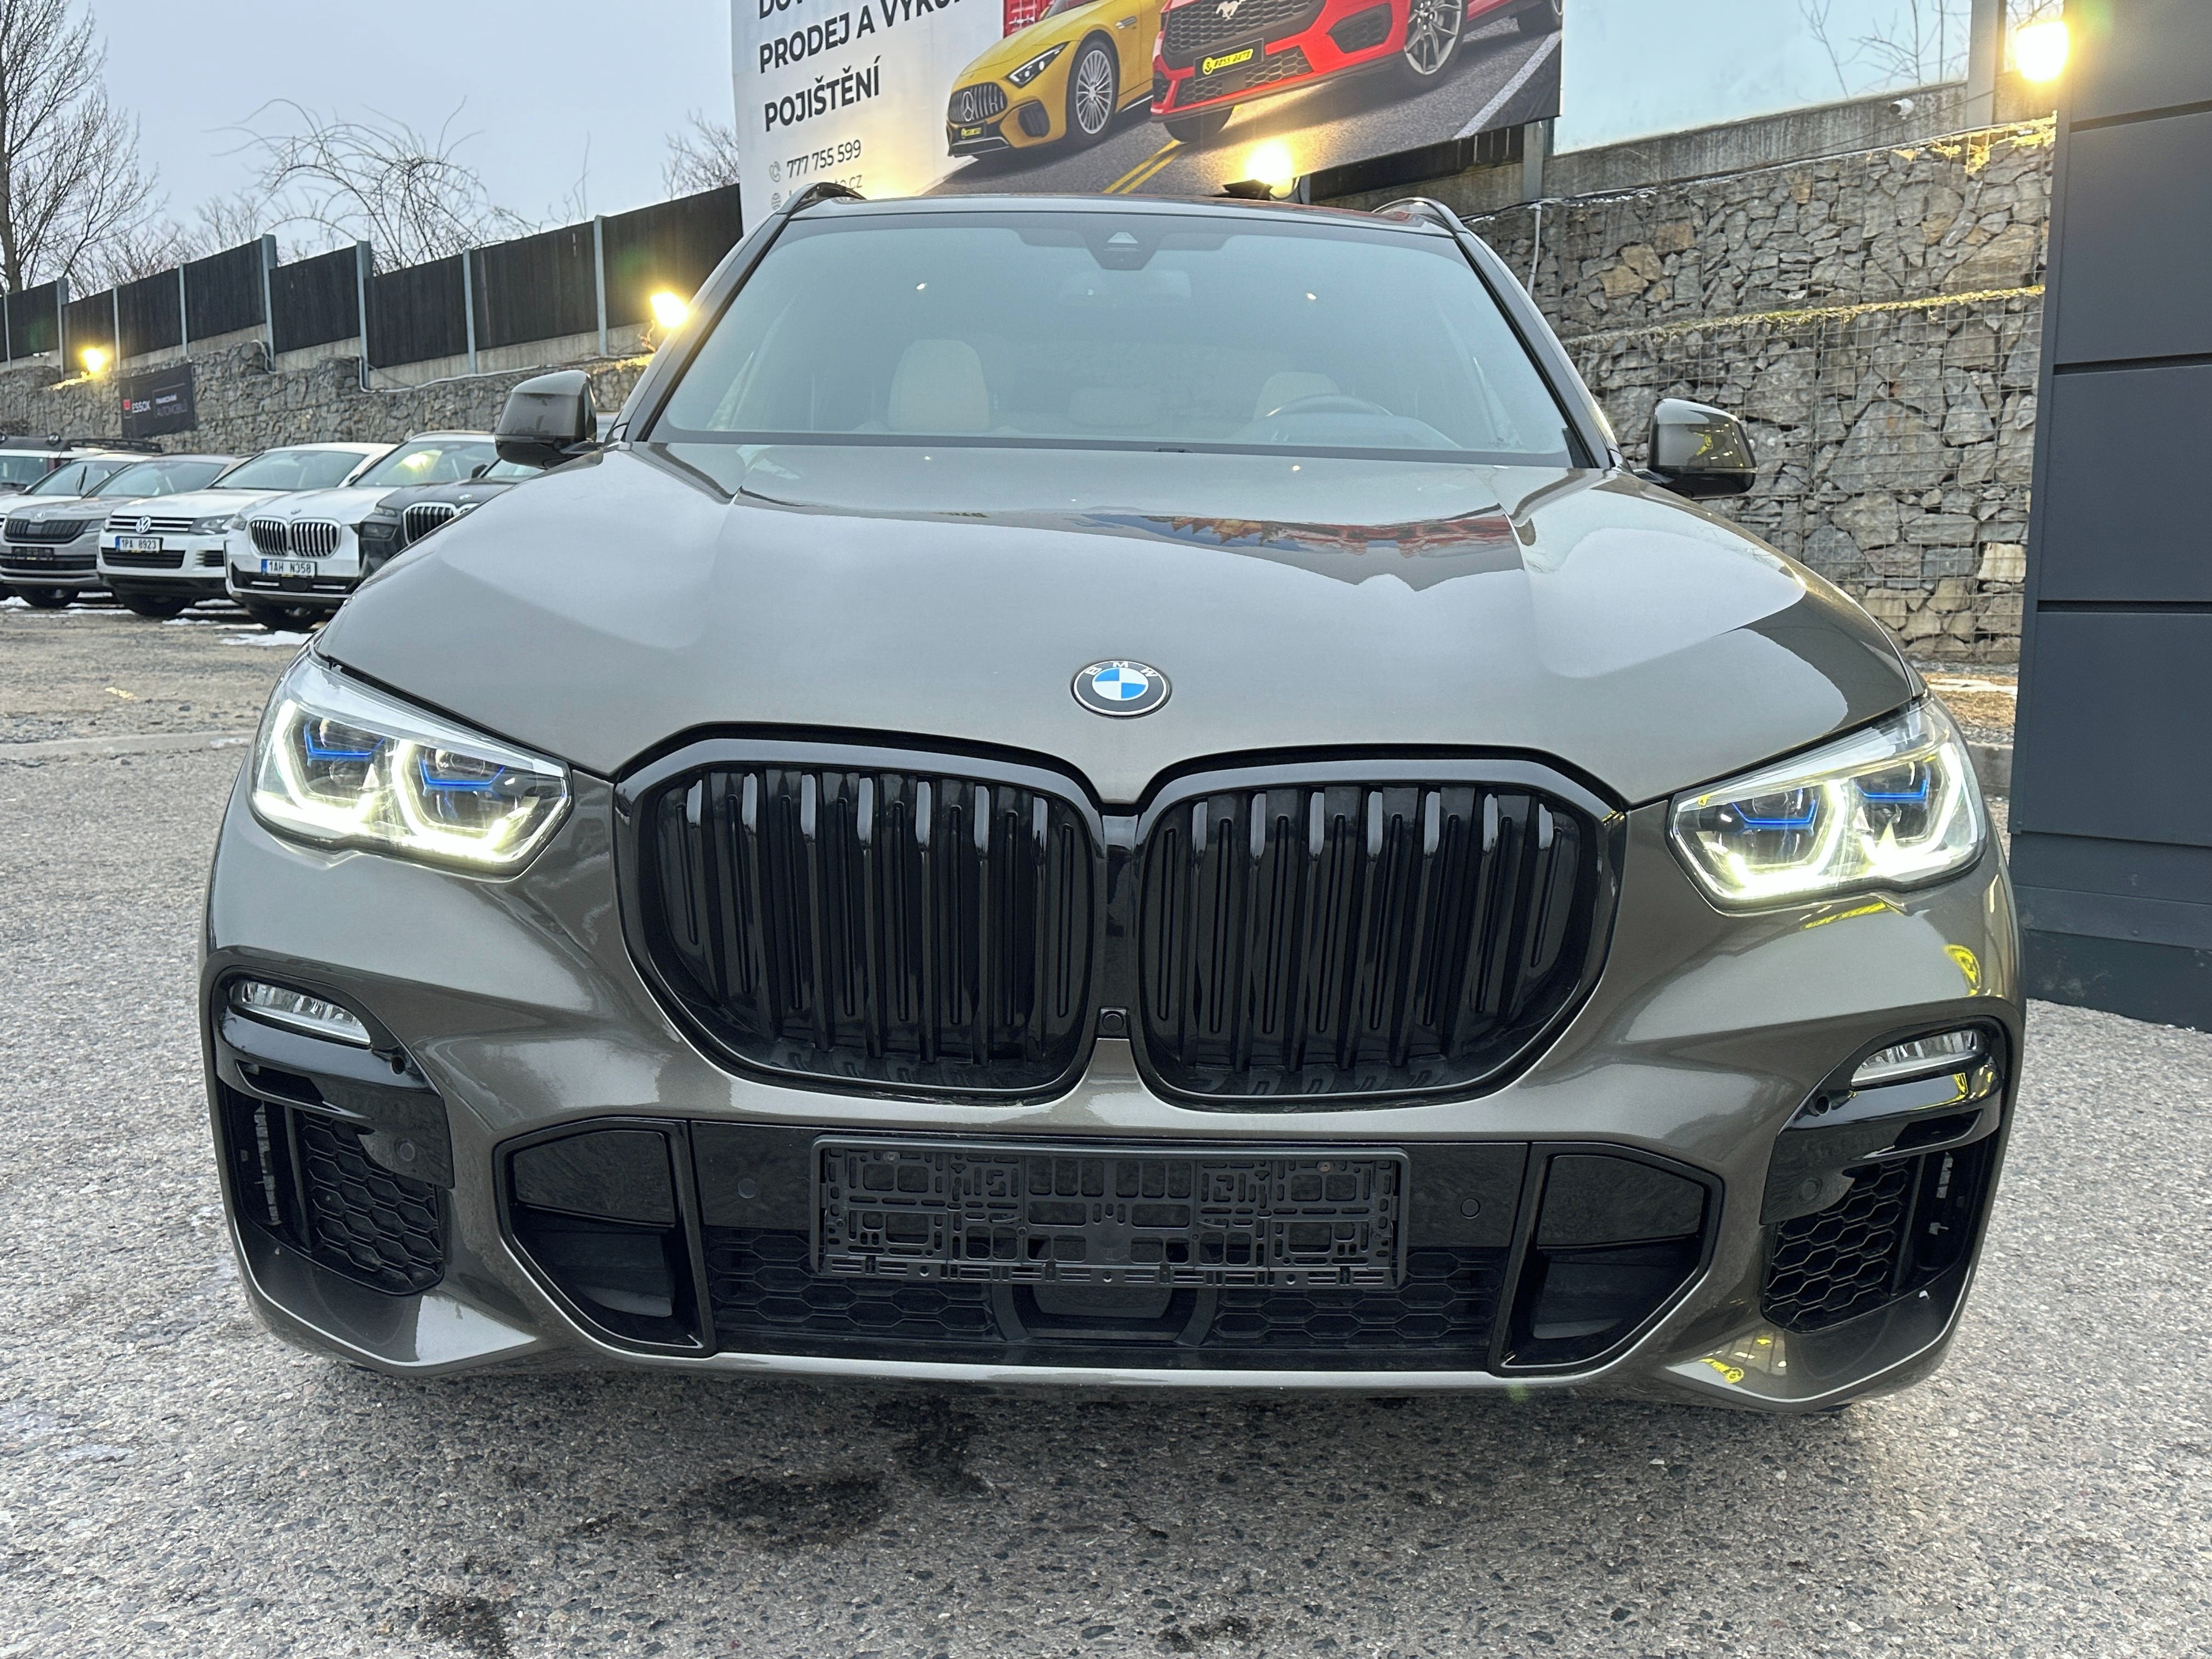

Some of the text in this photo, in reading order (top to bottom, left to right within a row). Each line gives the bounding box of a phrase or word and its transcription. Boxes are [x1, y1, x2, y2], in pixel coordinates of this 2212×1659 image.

[760, 0, 960, 74] PRODEJ A VYK
[765, 55, 882, 132] POJIŠTĚNÍ
[787, 139, 861, 178] 777 755 599
[122, 539, 156, 549] 1PA 8923
[269, 561, 312, 573] 1AH N358
[1085, 662, 1158, 677] BMW
